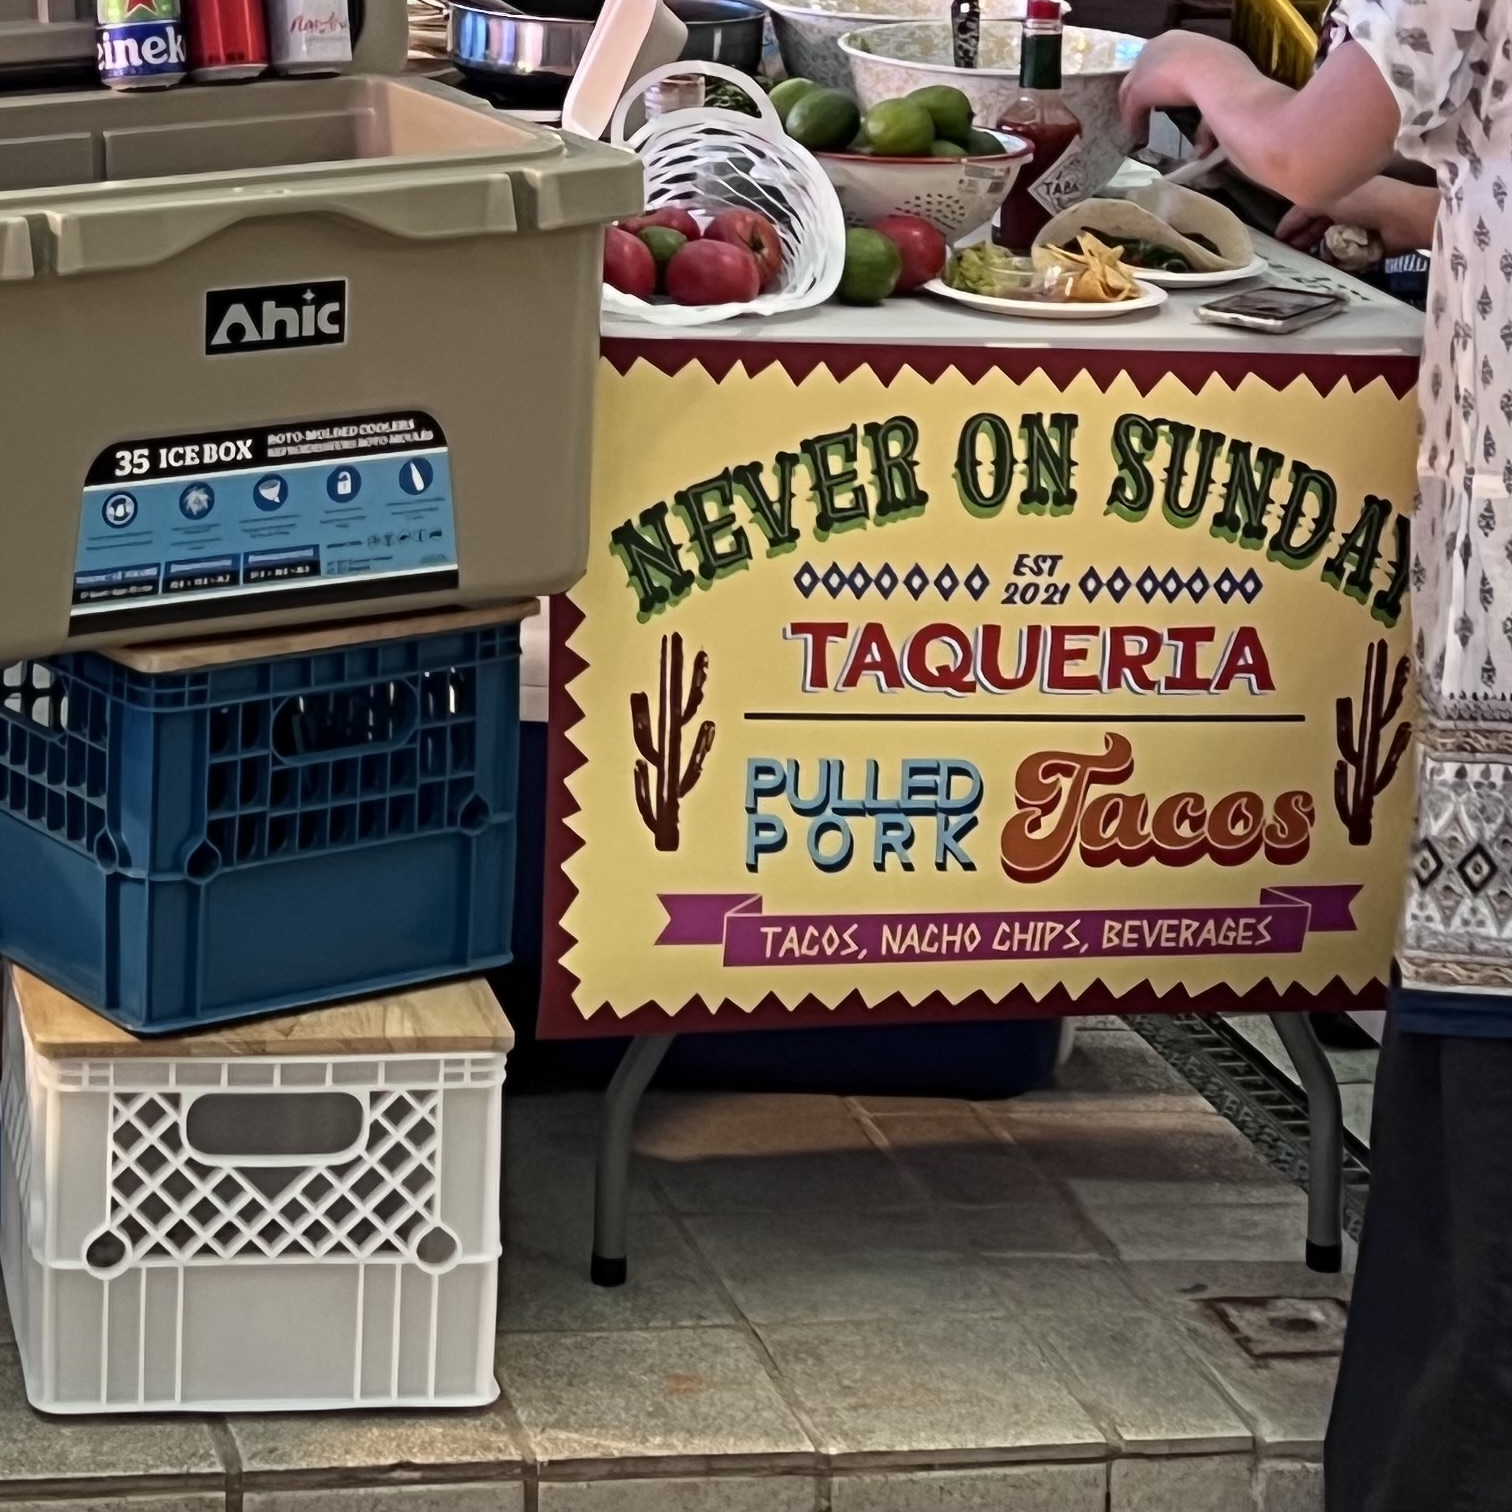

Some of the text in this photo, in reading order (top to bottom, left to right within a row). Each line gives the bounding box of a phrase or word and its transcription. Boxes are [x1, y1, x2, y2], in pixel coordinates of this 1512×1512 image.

[210, 289, 340, 345] Ahic
[114, 448, 151, 476] 35
[159, 443, 199, 470] ICE
[202, 438, 253, 465] BOX
[610, 414, 929, 624] NEVER
[951, 412, 1079, 519] ON
[1000, 582, 1071, 605] 2021
[1013, 553, 1063, 578] EST
[782, 621, 1276, 698] TAQUERIA
[744, 757, 984, 817] PULLED
[1001, 732, 1315, 884] Tacos
[744, 813, 978, 873] PORK
[760, 915, 1274, 960] TACOS, NACHO CHIPS, BEVERAGES
